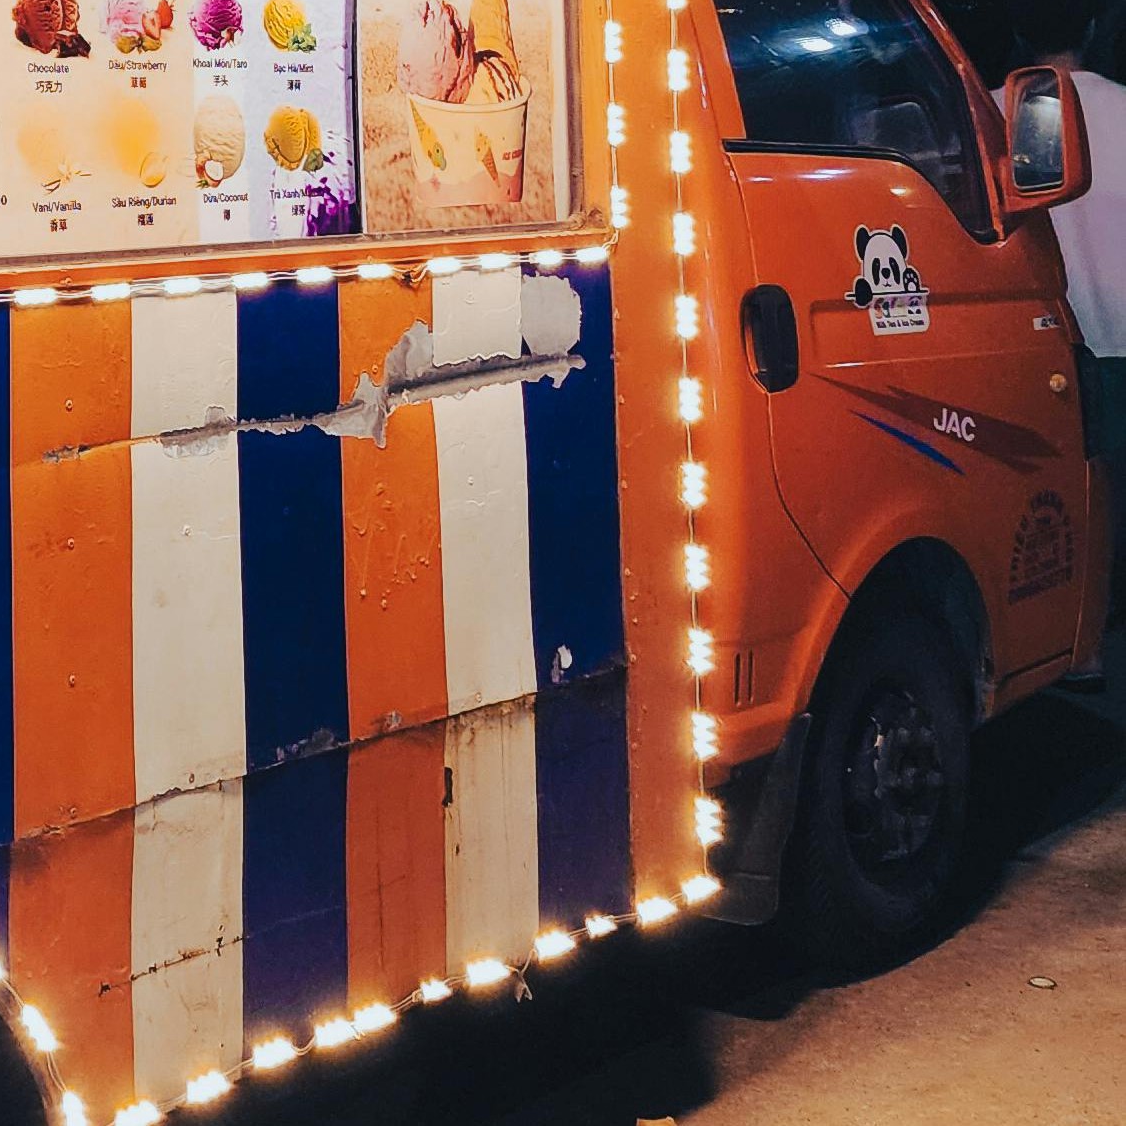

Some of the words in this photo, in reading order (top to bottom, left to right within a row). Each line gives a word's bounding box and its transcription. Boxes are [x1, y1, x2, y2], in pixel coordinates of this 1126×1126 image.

[27, 62, 69, 73] Chocolate
[193, 58, 212, 69] Khoai
[35, 80, 63, 93] 巧克力
[934, 408, 976, 441] JAC
